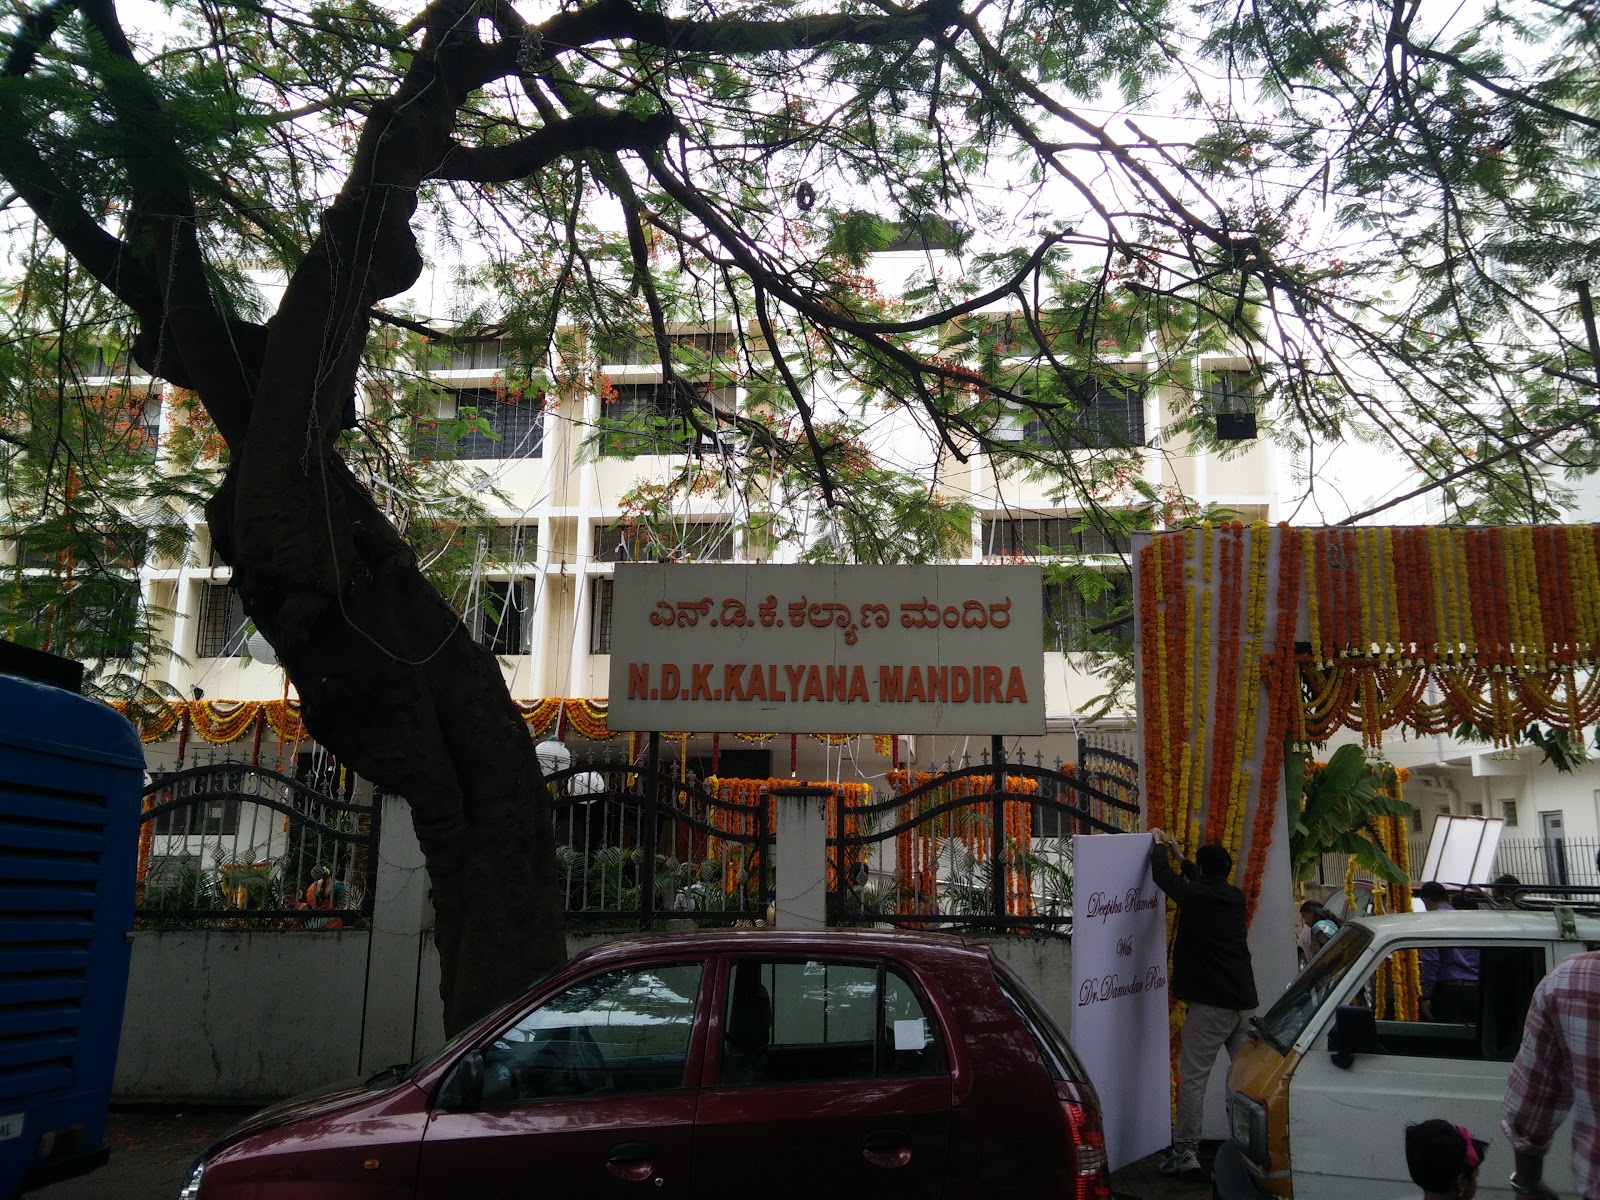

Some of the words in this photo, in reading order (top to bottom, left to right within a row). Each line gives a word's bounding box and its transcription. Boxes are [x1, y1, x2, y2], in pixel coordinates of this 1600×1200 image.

[900, 596, 1011, 628] ಮಂದಿರ
[879, 665, 1028, 703] MANDIRA
[1086, 891, 1122, 924] Deepika
[1125, 888, 1158, 912] Ramesh
[1145, 966, 1166, 992] Rao
